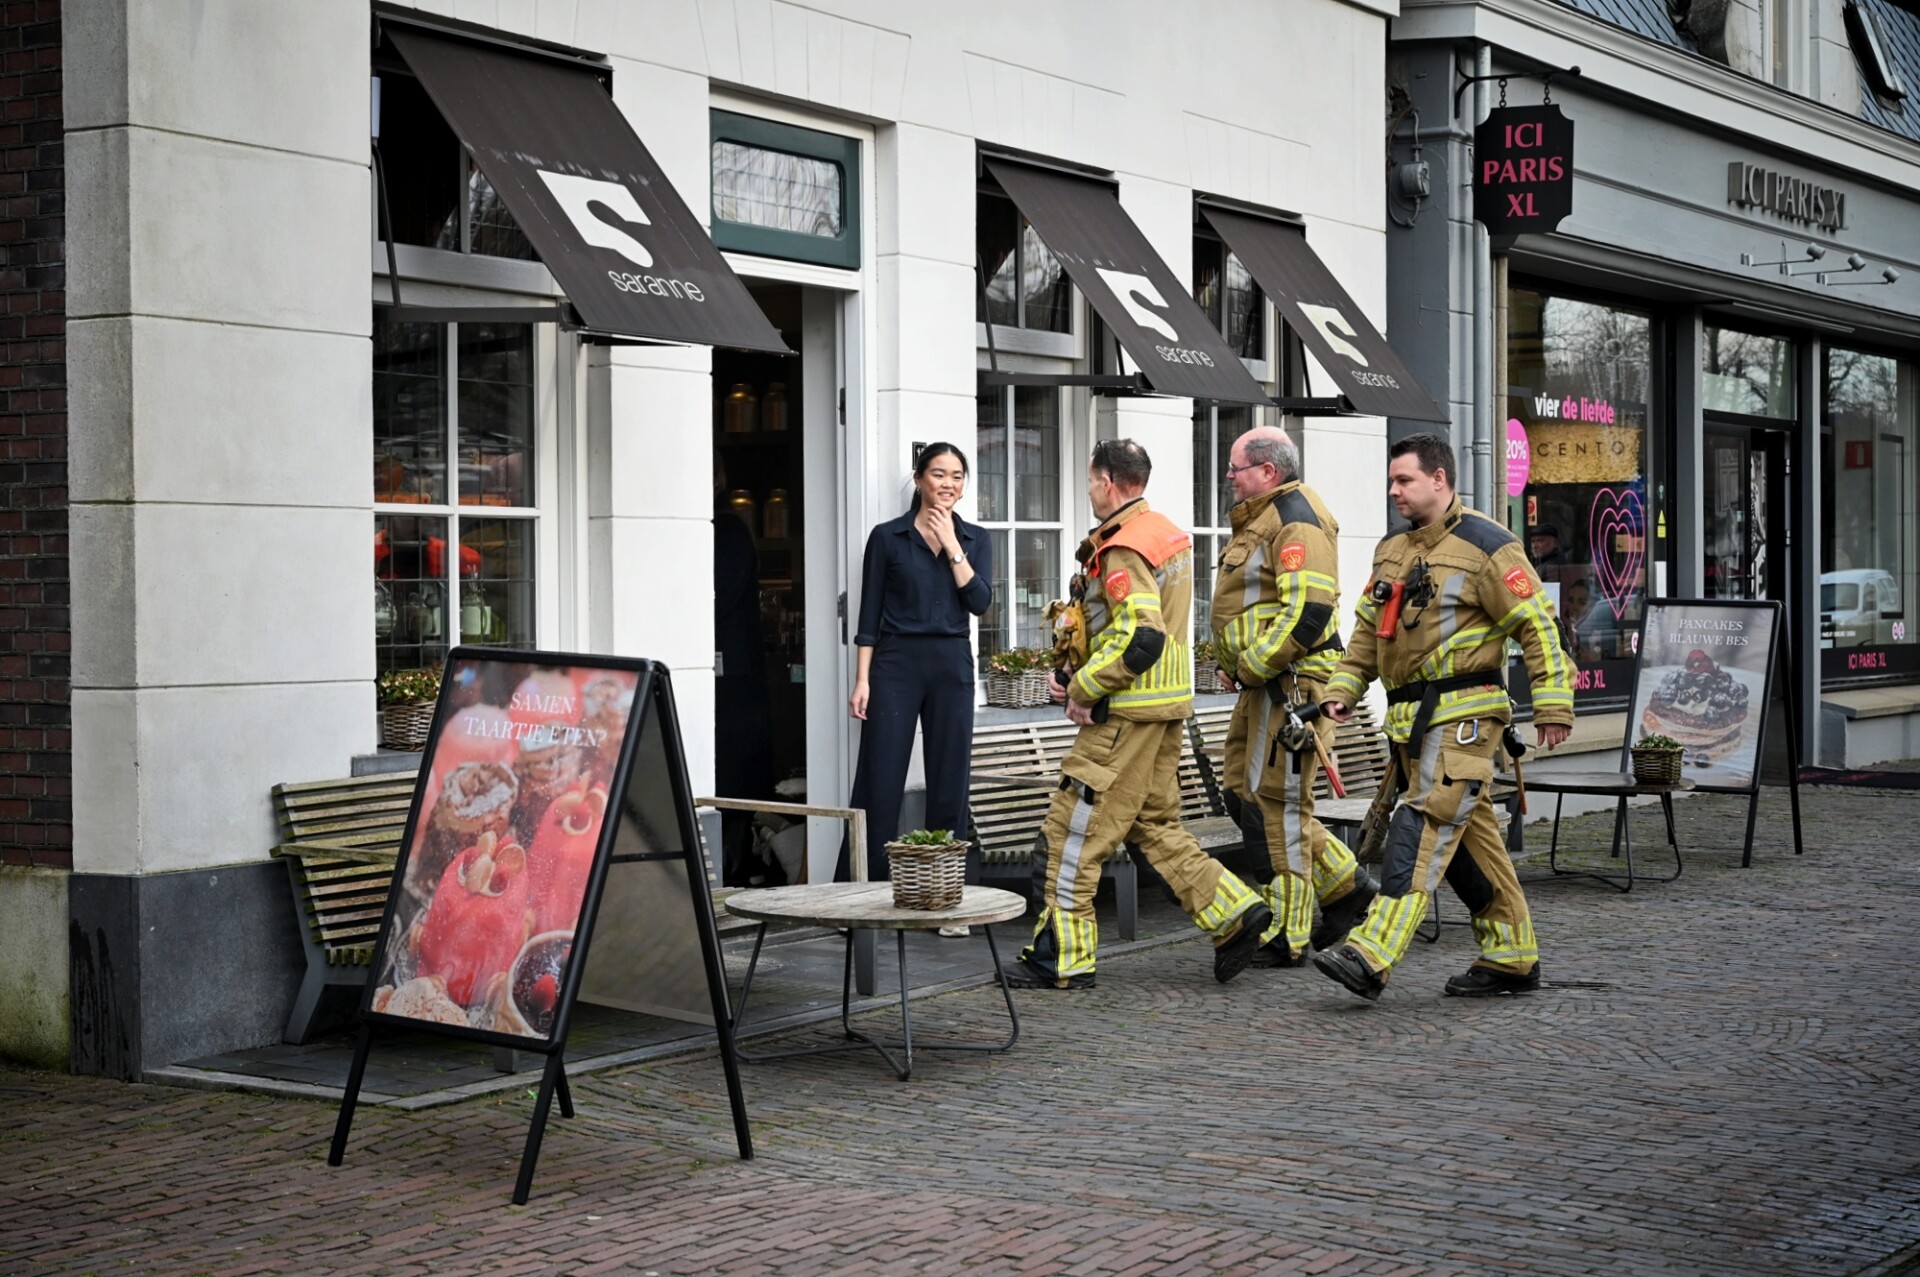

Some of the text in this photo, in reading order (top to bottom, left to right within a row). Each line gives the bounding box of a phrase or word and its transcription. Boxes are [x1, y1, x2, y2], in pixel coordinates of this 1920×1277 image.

[1505, 123, 1543, 149] ICI
[1483, 156, 1564, 185] PARIS
[1736, 162, 1768, 207] ICI
[1775, 171, 1826, 222] PARIS
[1506, 192, 1540, 217] XL
[608, 270, 705, 302] saranne
[1155, 345, 1215, 368] saranne
[1351, 370, 1400, 390] saranne
[1534, 391, 1615, 424] vier de liefde
[1537, 441, 1625, 457] CENTO
[1679, 618, 1744, 631] PANCAKES
[1669, 633, 1749, 646] BLAUWE BES
[1848, 652, 1887, 670] ICI PARIS XL
[1593, 669, 1606, 688] XL
[510, 691, 577, 715] SAMEN
[464, 716, 608, 747] TAARTJE ETEN?
